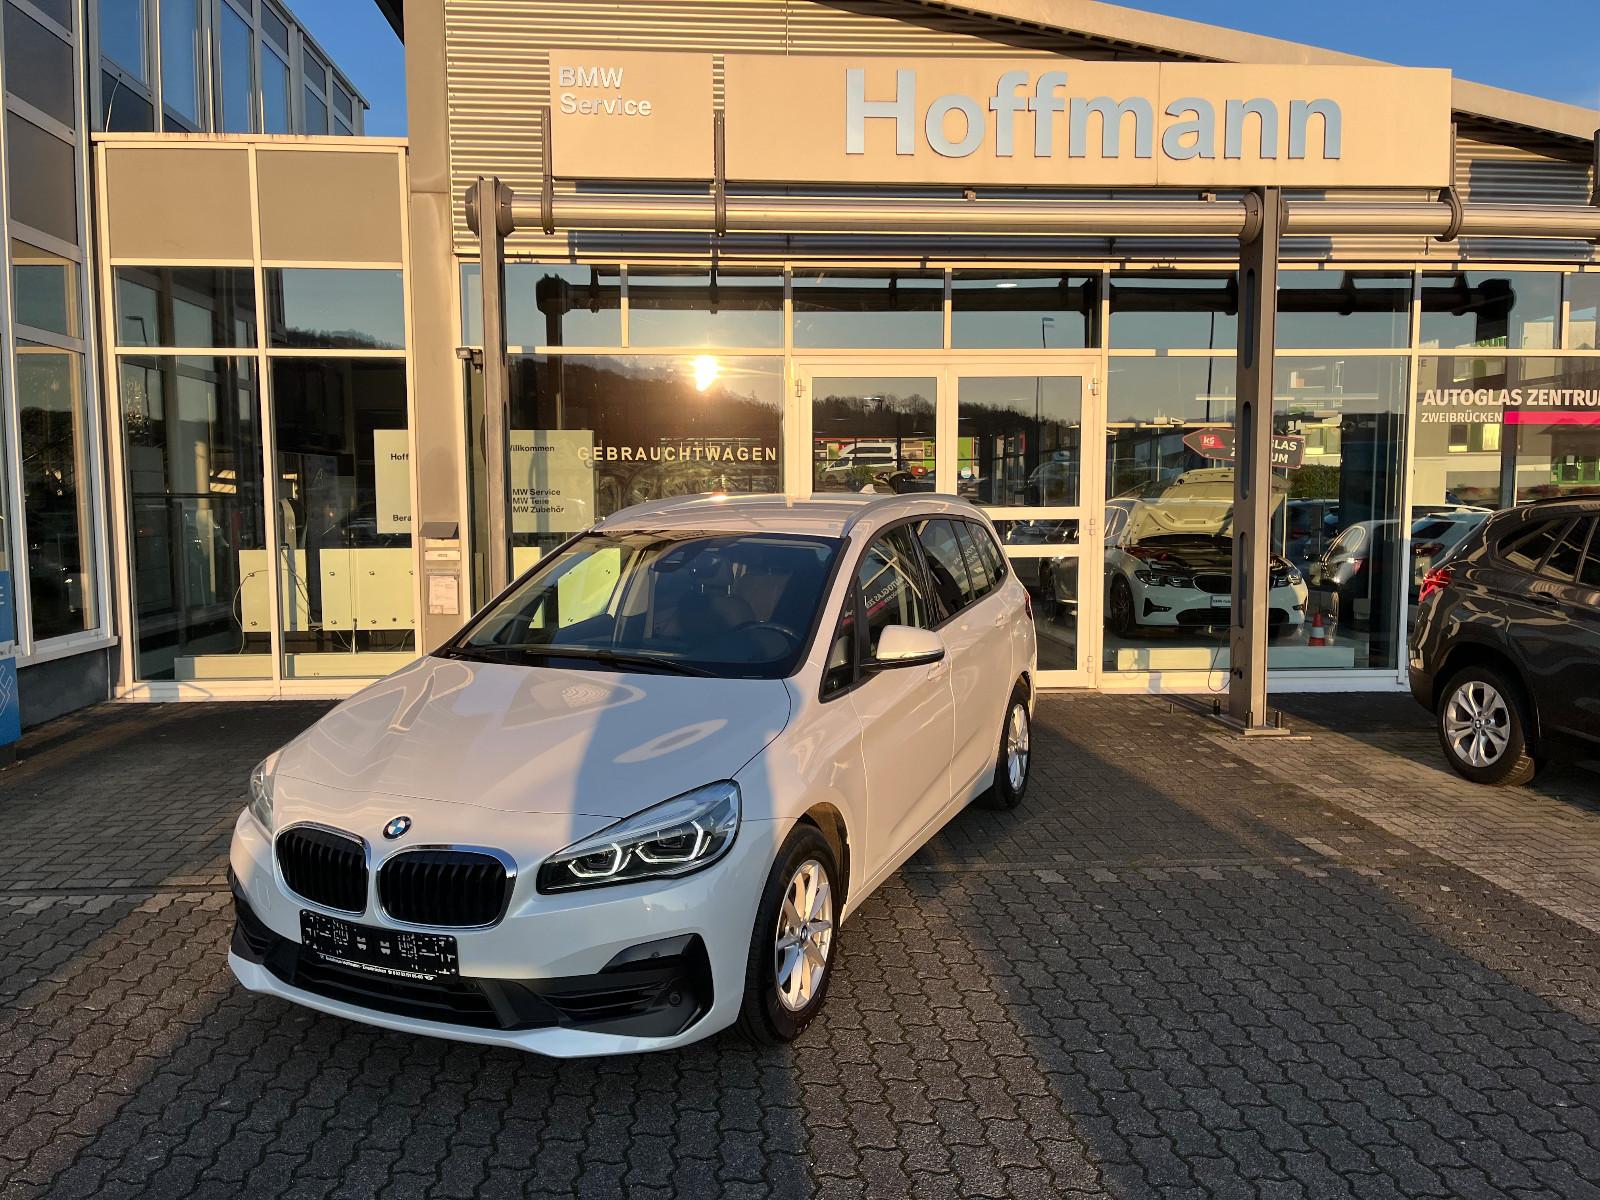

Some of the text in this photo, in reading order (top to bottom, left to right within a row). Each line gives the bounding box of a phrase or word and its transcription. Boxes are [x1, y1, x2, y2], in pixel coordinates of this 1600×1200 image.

[559, 65, 623, 89] BMW
[559, 92, 652, 116] Service
[845, 68, 1342, 160] Hoffmann
[1422, 388, 1600, 406] AUTOGLAS ZENTRU
[1421, 410, 1503, 423] ZWEIBRÜCKEN
[510, 444, 555, 452] illkommen
[577, 446, 777, 462] GEBRAUCHTWAGEN
[390, 452, 409, 461] Hoff
[512, 488, 561, 496] MW Service
[512, 497, 550, 505] MW Teile
[392, 514, 412, 522] Bera
